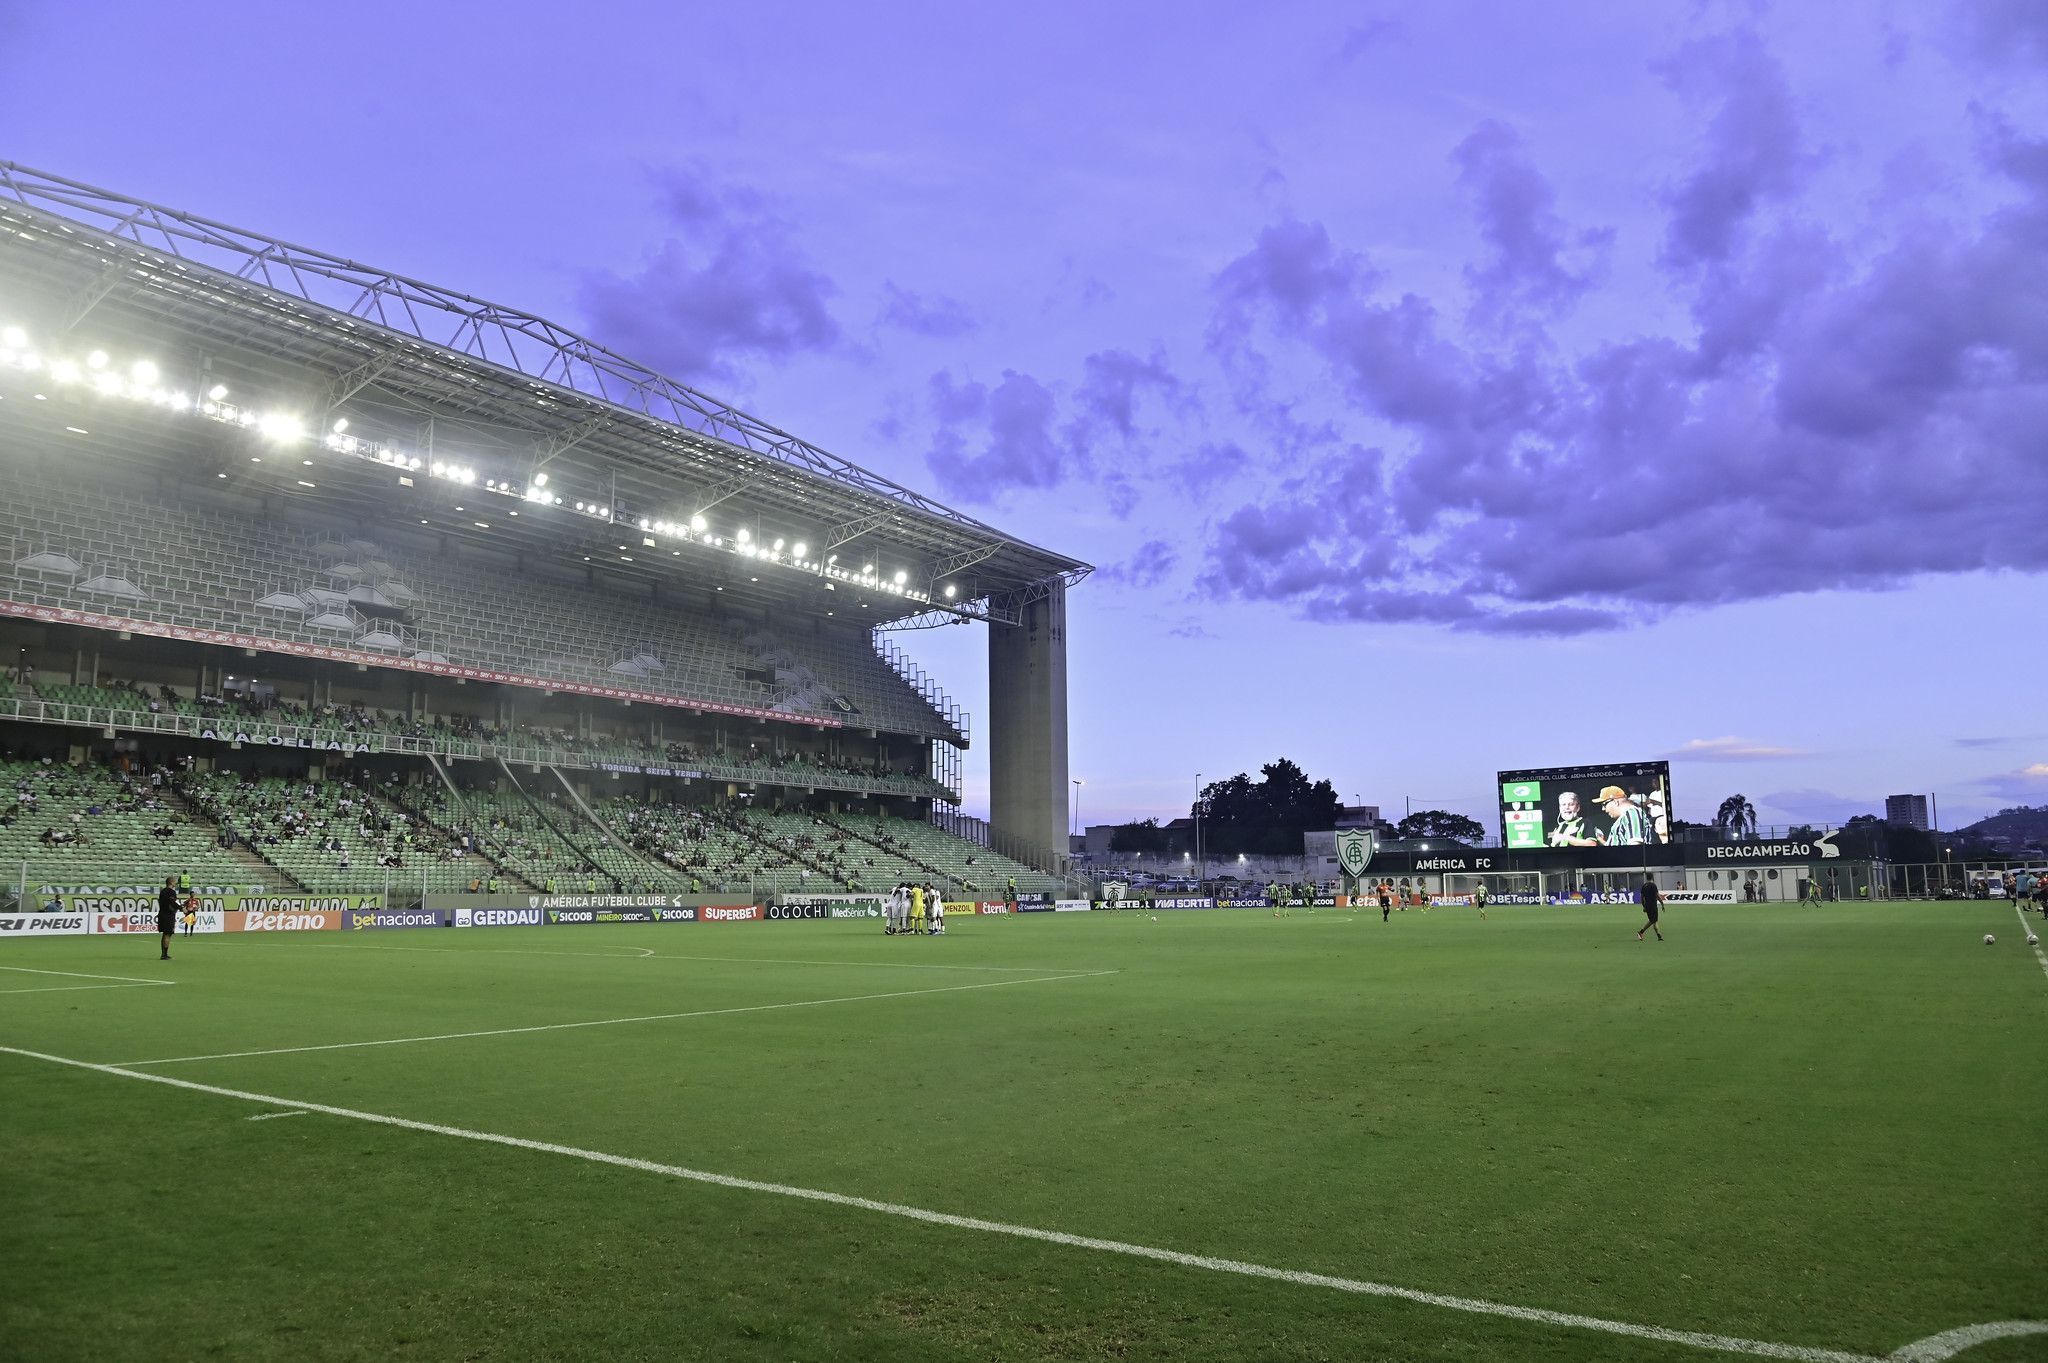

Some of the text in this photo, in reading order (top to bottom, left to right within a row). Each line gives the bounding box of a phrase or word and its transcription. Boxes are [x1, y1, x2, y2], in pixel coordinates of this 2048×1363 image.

[200, 729, 370, 753] AVACOELHADA
[646, 767, 671, 777] SEITA
[674, 769, 702, 779] VERDE
[1707, 842, 1810, 858] DECACAMPEÃO
[1415, 857, 1491, 870] AMÉRICA FC
[543, 895, 667, 908] AMÉRICA FUTEBOL CLUBE
[1154, 898, 1210, 908] VIVA SORTE
[1702, 893, 1733, 901] PNEUS
[1217, 898, 1266, 909] betnacional
[473, 909, 540, 926] GERDAU
[559, 910, 593, 922] SICOOB
[596, 914, 623, 922] MINEIRO
[662, 909, 694, 920] SICOOB
[705, 906, 758, 920] SUPERBET
[770, 906, 828, 918] OGOCHI
[29, 918, 83, 930] PNEUS
[244, 911, 325, 931] Betano
[352, 912, 436, 928] betnacional
